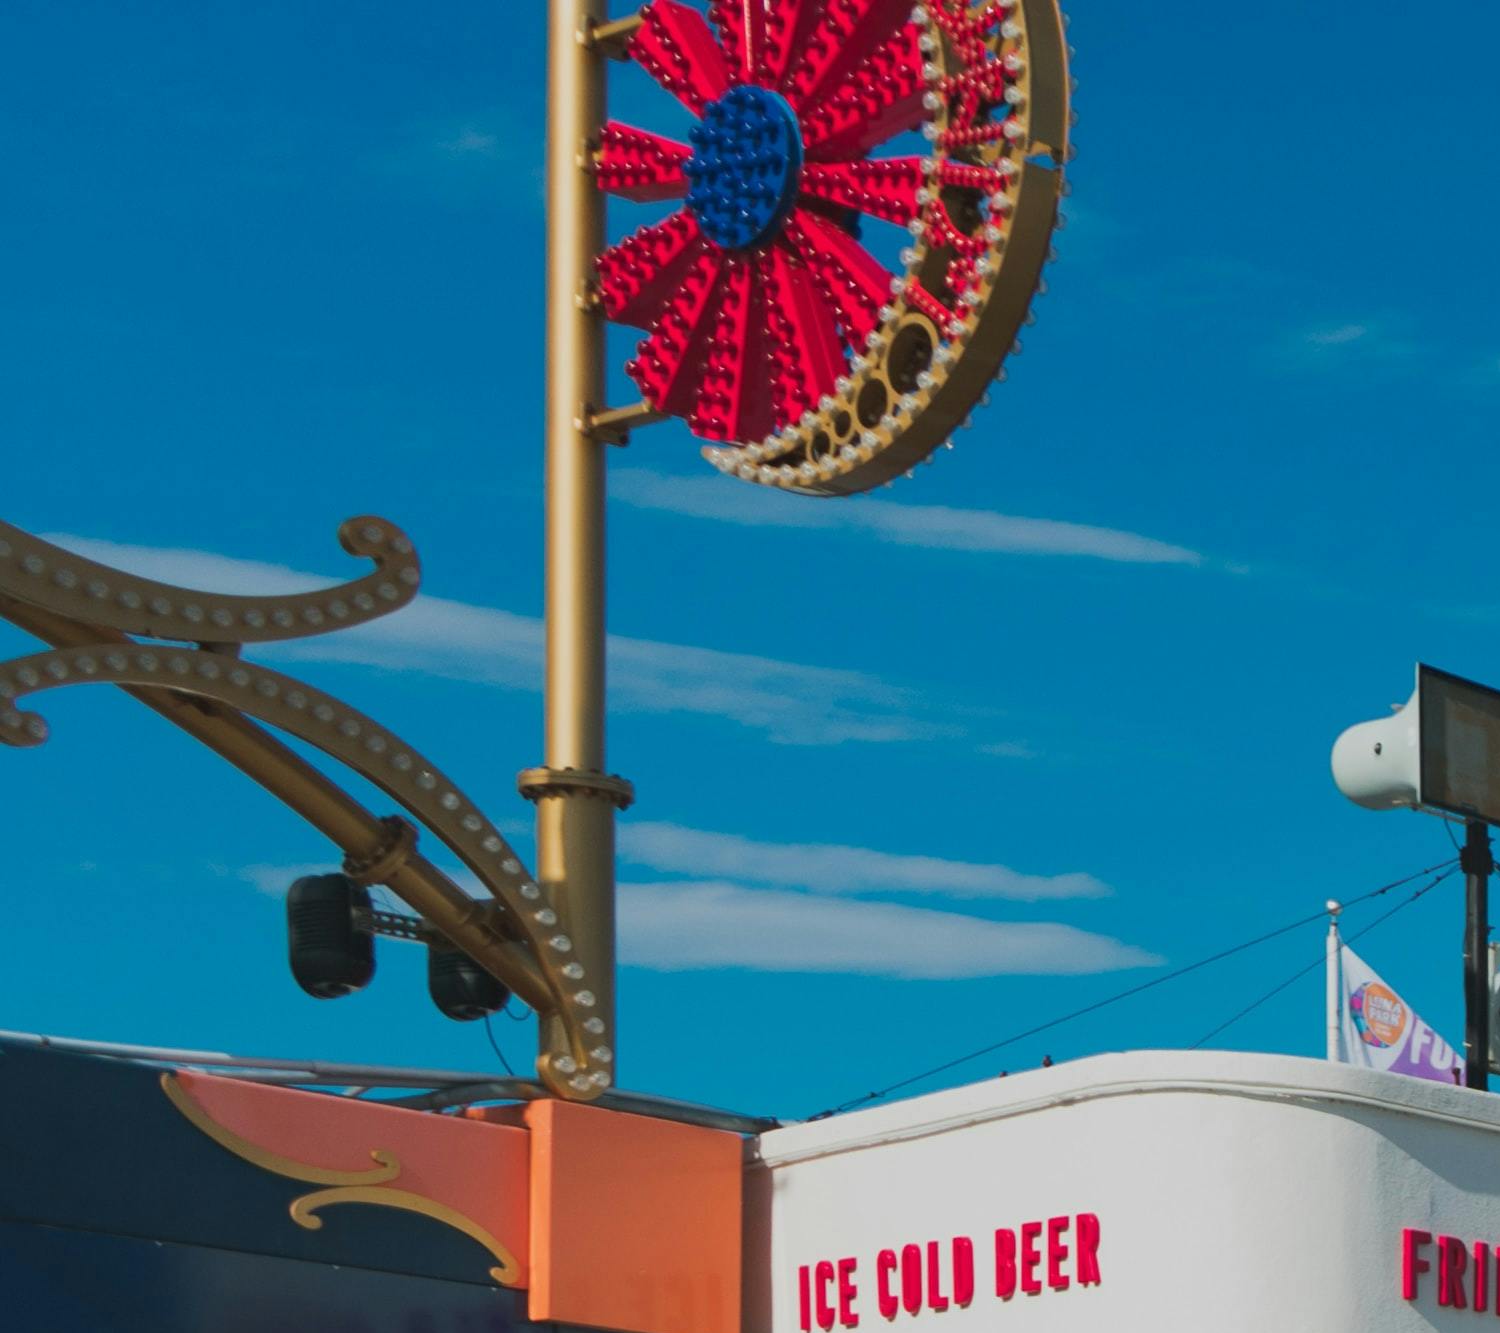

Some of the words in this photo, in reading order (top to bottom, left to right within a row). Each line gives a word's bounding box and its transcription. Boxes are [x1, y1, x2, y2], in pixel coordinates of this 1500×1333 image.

[800, 1257, 859, 1333] ICE
[877, 1236, 975, 1320] COLD
[995, 1213, 1101, 1301] BEER
